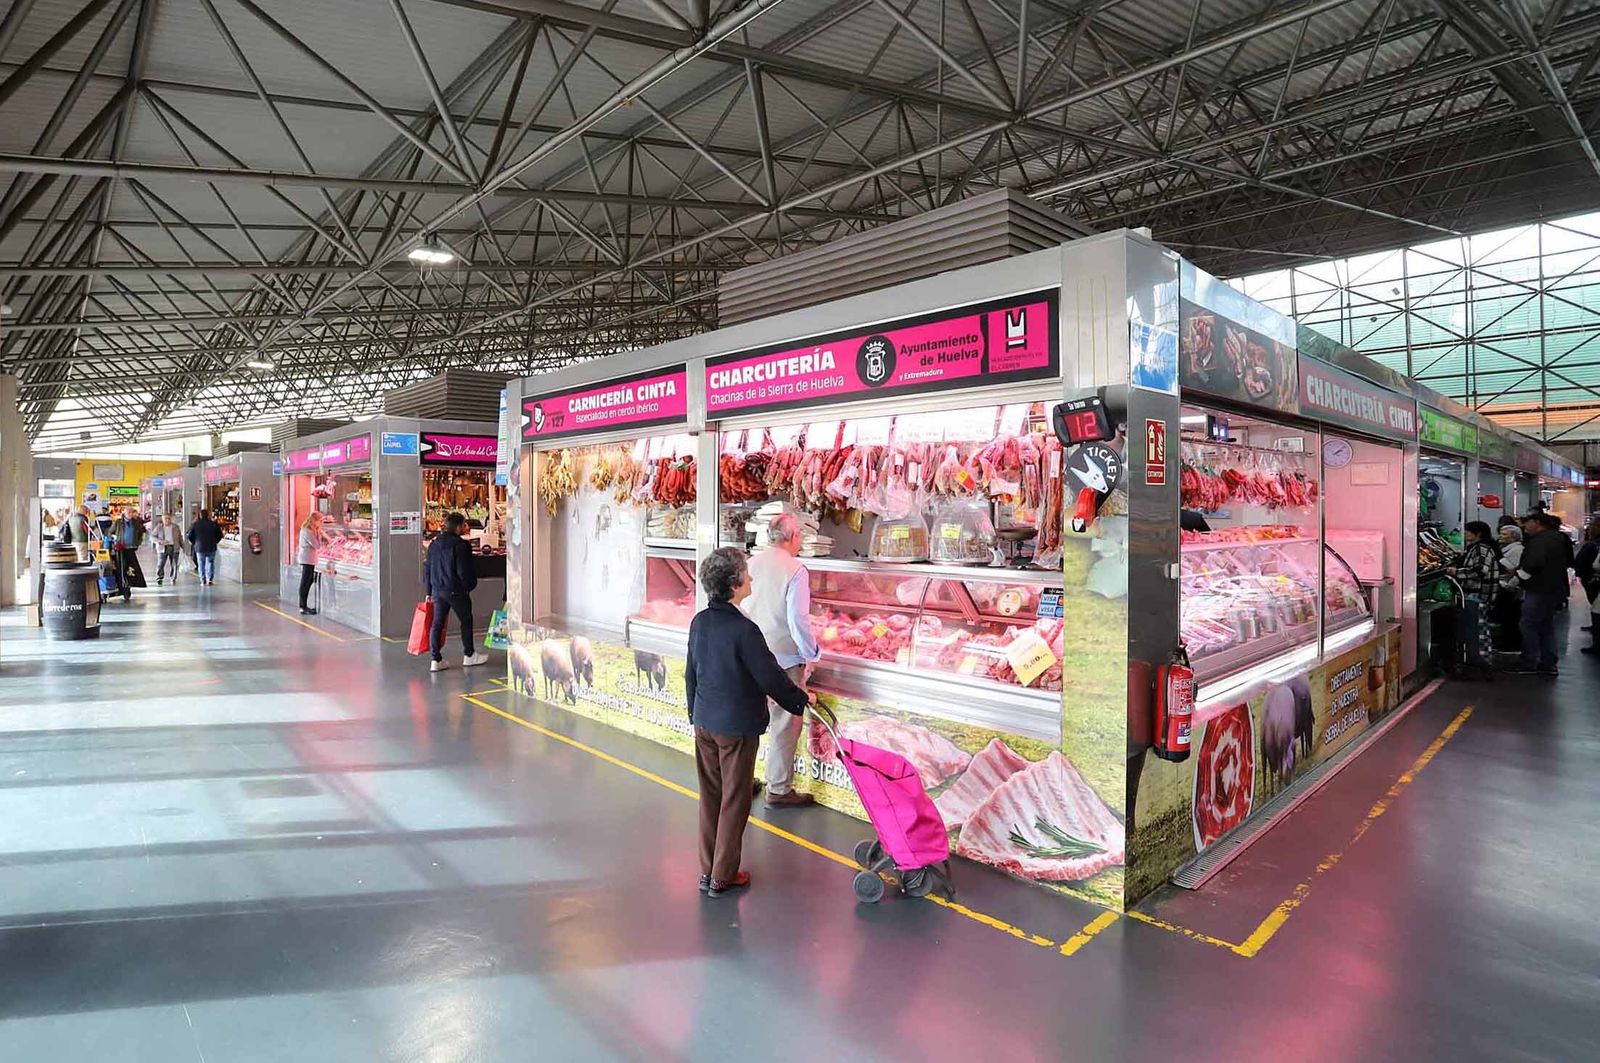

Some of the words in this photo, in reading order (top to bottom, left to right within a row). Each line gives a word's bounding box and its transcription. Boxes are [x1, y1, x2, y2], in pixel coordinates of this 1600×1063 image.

[900, 334, 978, 357] Ayuntamiento
[920, 354, 934, 366] de
[937, 348, 978, 363] Huelva
[710, 347, 836, 389] CHARCUTERÍA
[904, 368, 944, 380] Extremadura
[568, 386, 634, 413] CARNICERÍA
[637, 380, 676, 401] CINTA
[710, 391, 744, 405] Chacinas
[745, 388, 756, 400] de
[758, 386, 766, 398] la
[768, 383, 794, 397] Sierra
[796, 380, 808, 392] de
[811, 375, 844, 390] Huelva
[1306, 374, 1386, 425] CHARCUTERÍA
[1389, 405, 1414, 432] CINTA
[576, 411, 608, 423] Especialidad
[609, 410, 617, 419] en
[618, 407, 635, 417] cerdo
[637, 402, 659, 414] ibérico
[1076, 411, 1098, 438] 12
[1087, 446, 1117, 483] TICKET
